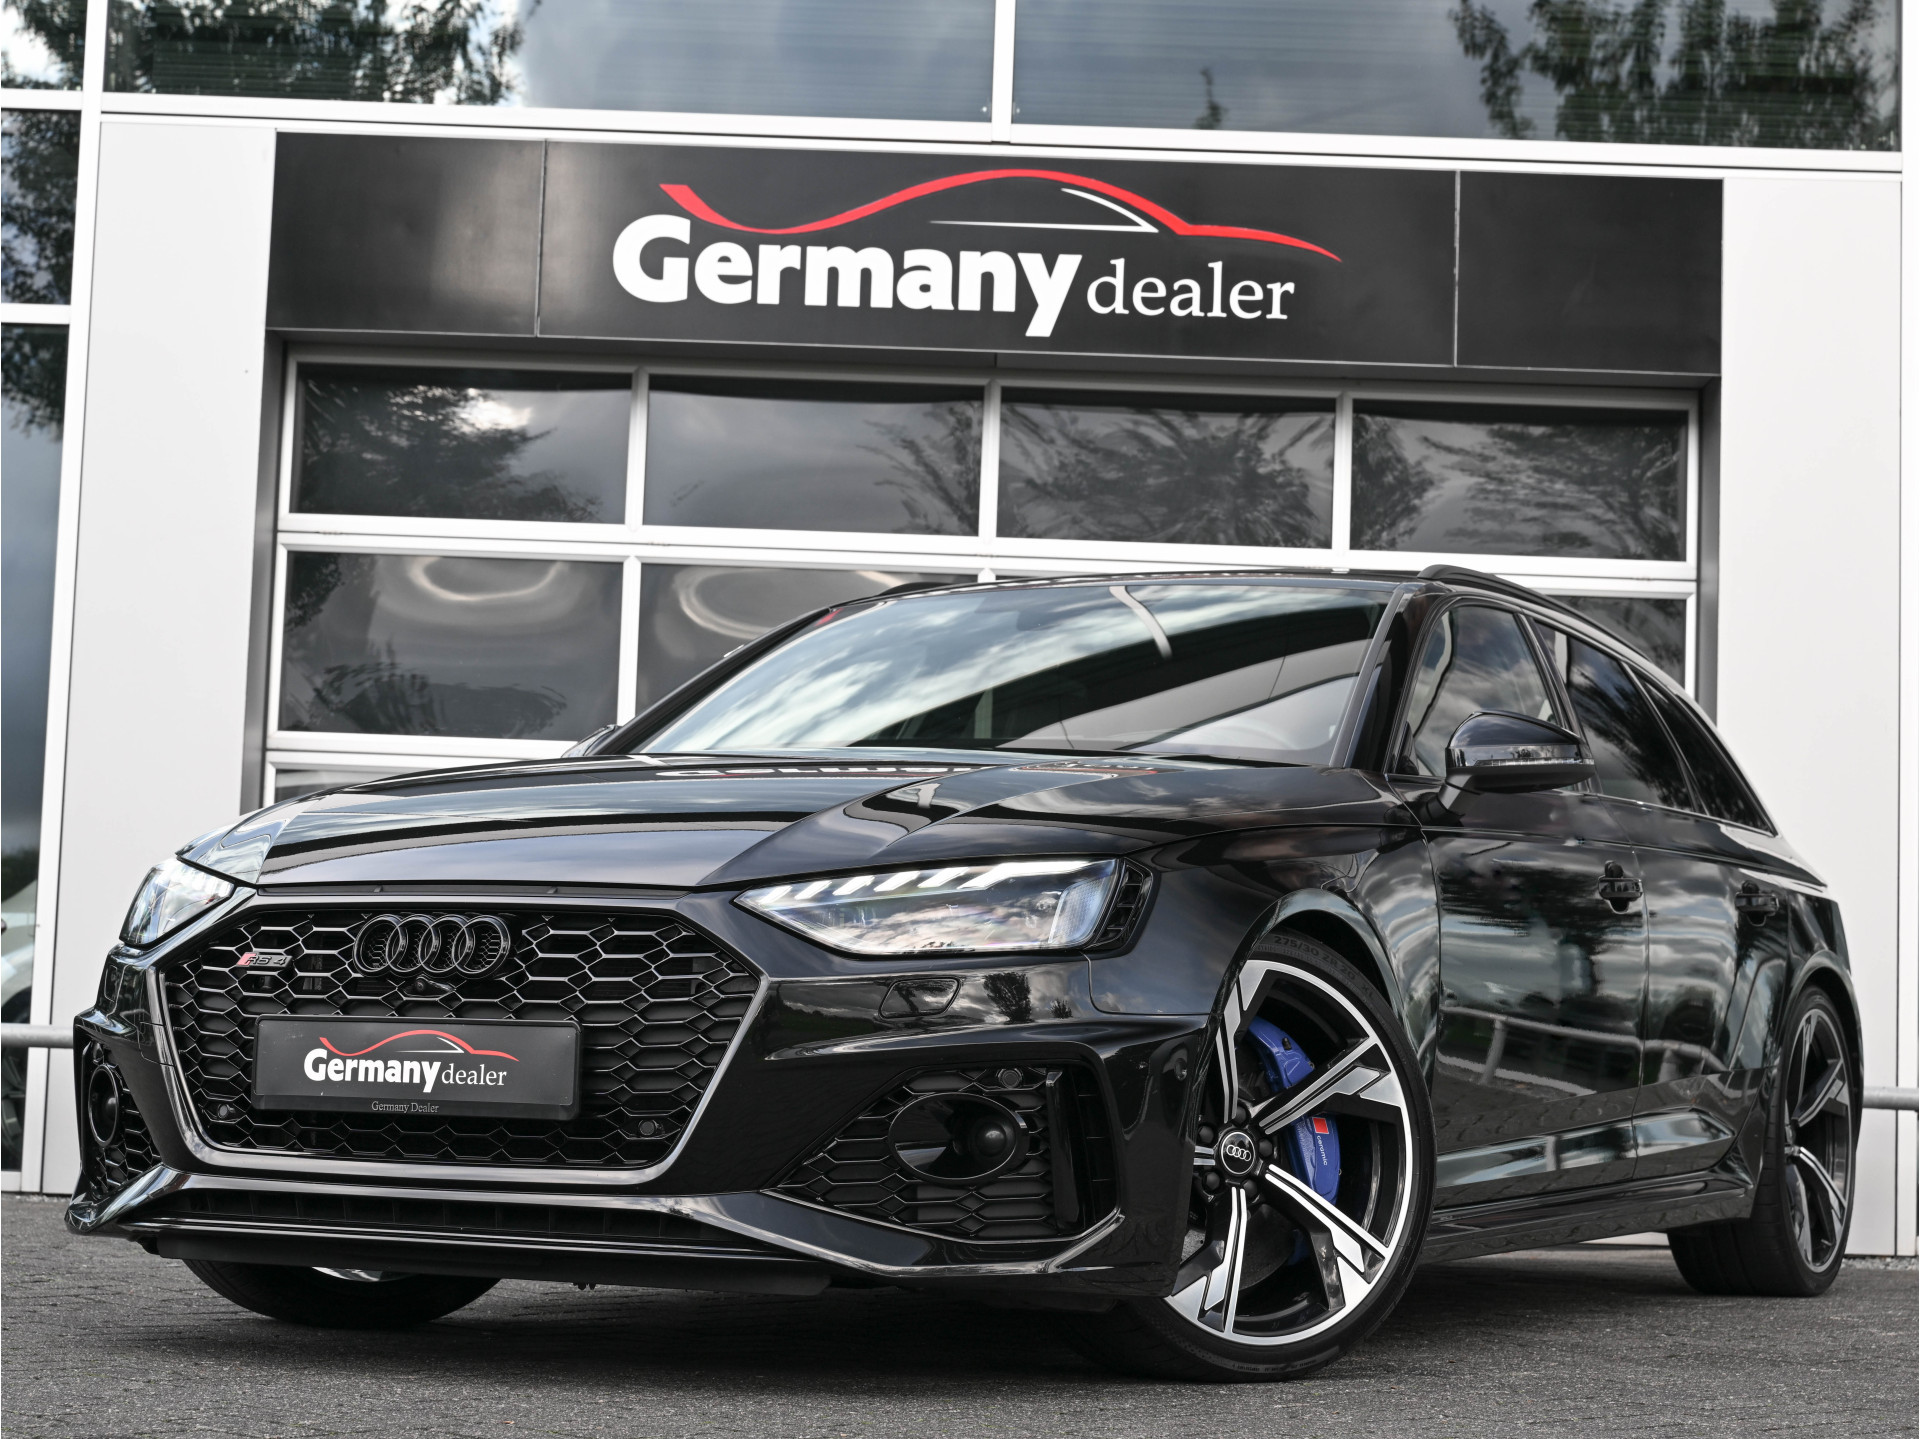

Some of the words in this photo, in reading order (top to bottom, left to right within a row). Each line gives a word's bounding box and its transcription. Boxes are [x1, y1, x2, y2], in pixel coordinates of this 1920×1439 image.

[612, 214, 1083, 337] Germany
[1086, 257, 1295, 320] dealer
[1274, 935, 1320, 957] 275/30
[303, 1048, 442, 1093] Germany
[441, 1062, 508, 1086] dealer
[371, 1100, 410, 1114] Germany
[410, 1102, 440, 1113] Dealer
[1316, 1135, 1328, 1166] ceramic
